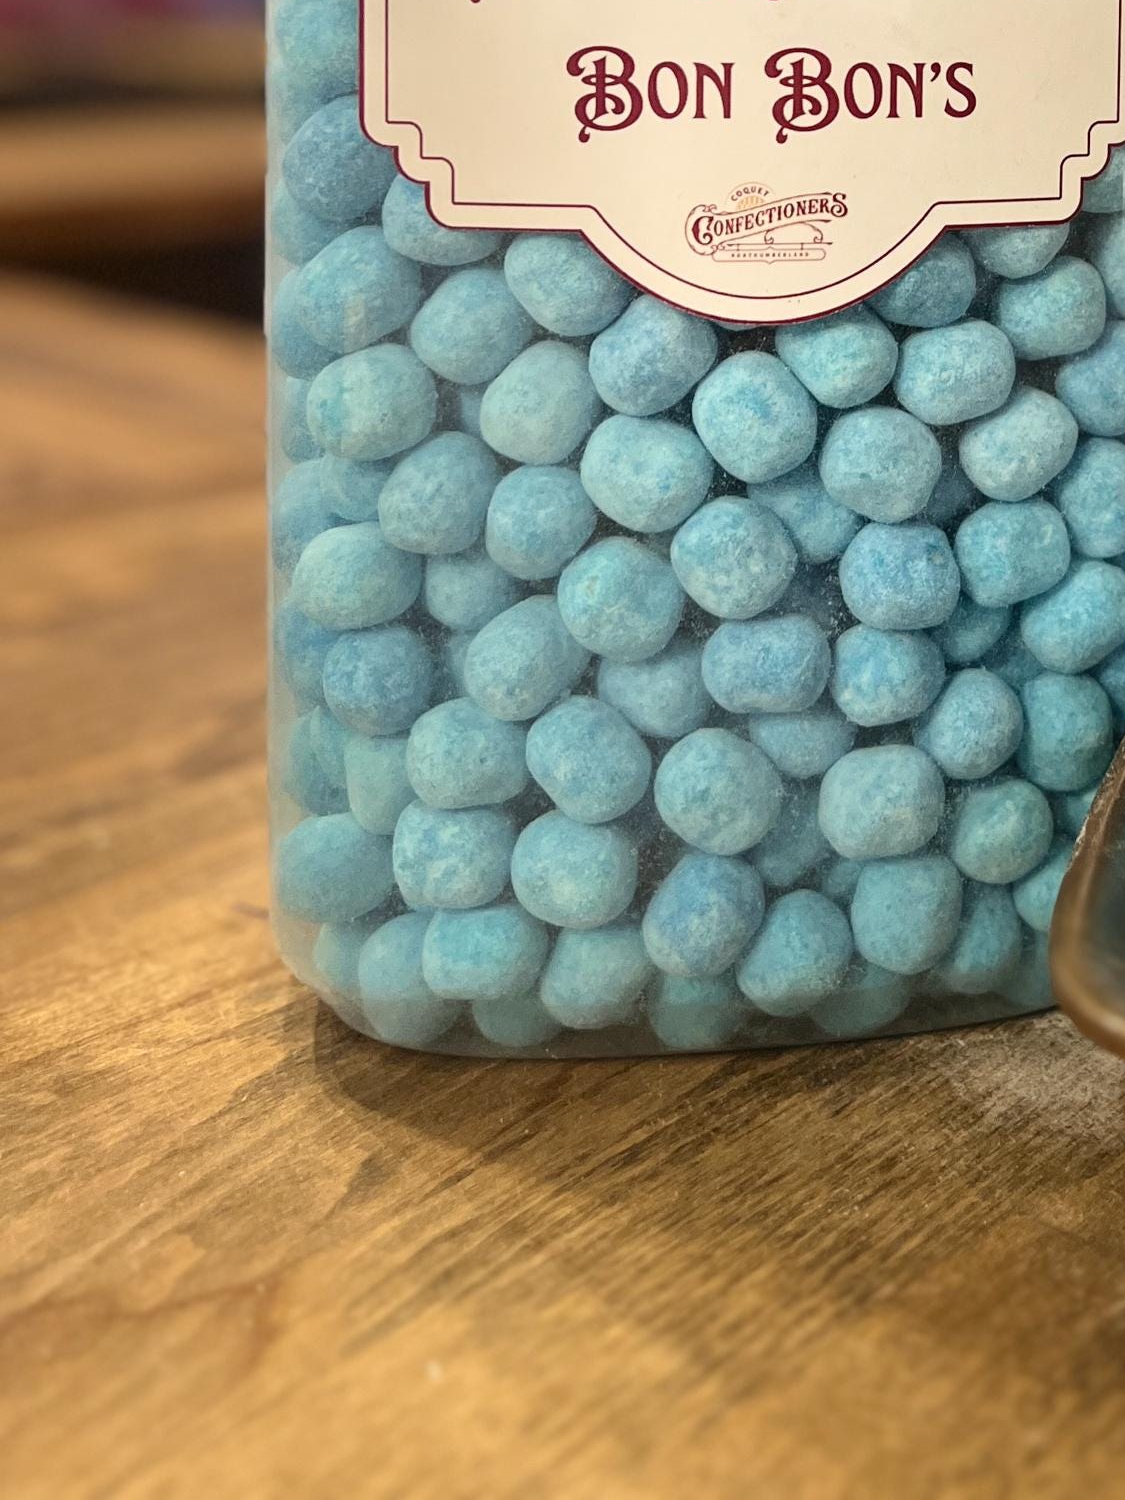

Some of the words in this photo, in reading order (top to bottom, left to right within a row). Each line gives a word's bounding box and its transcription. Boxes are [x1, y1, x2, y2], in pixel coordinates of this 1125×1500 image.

[566, 45, 735, 144] BON
[764, 47, 978, 145] BON'S
[691, 192, 849, 246] CONFECTIONERS
[730, 185, 770, 202] COQUET
